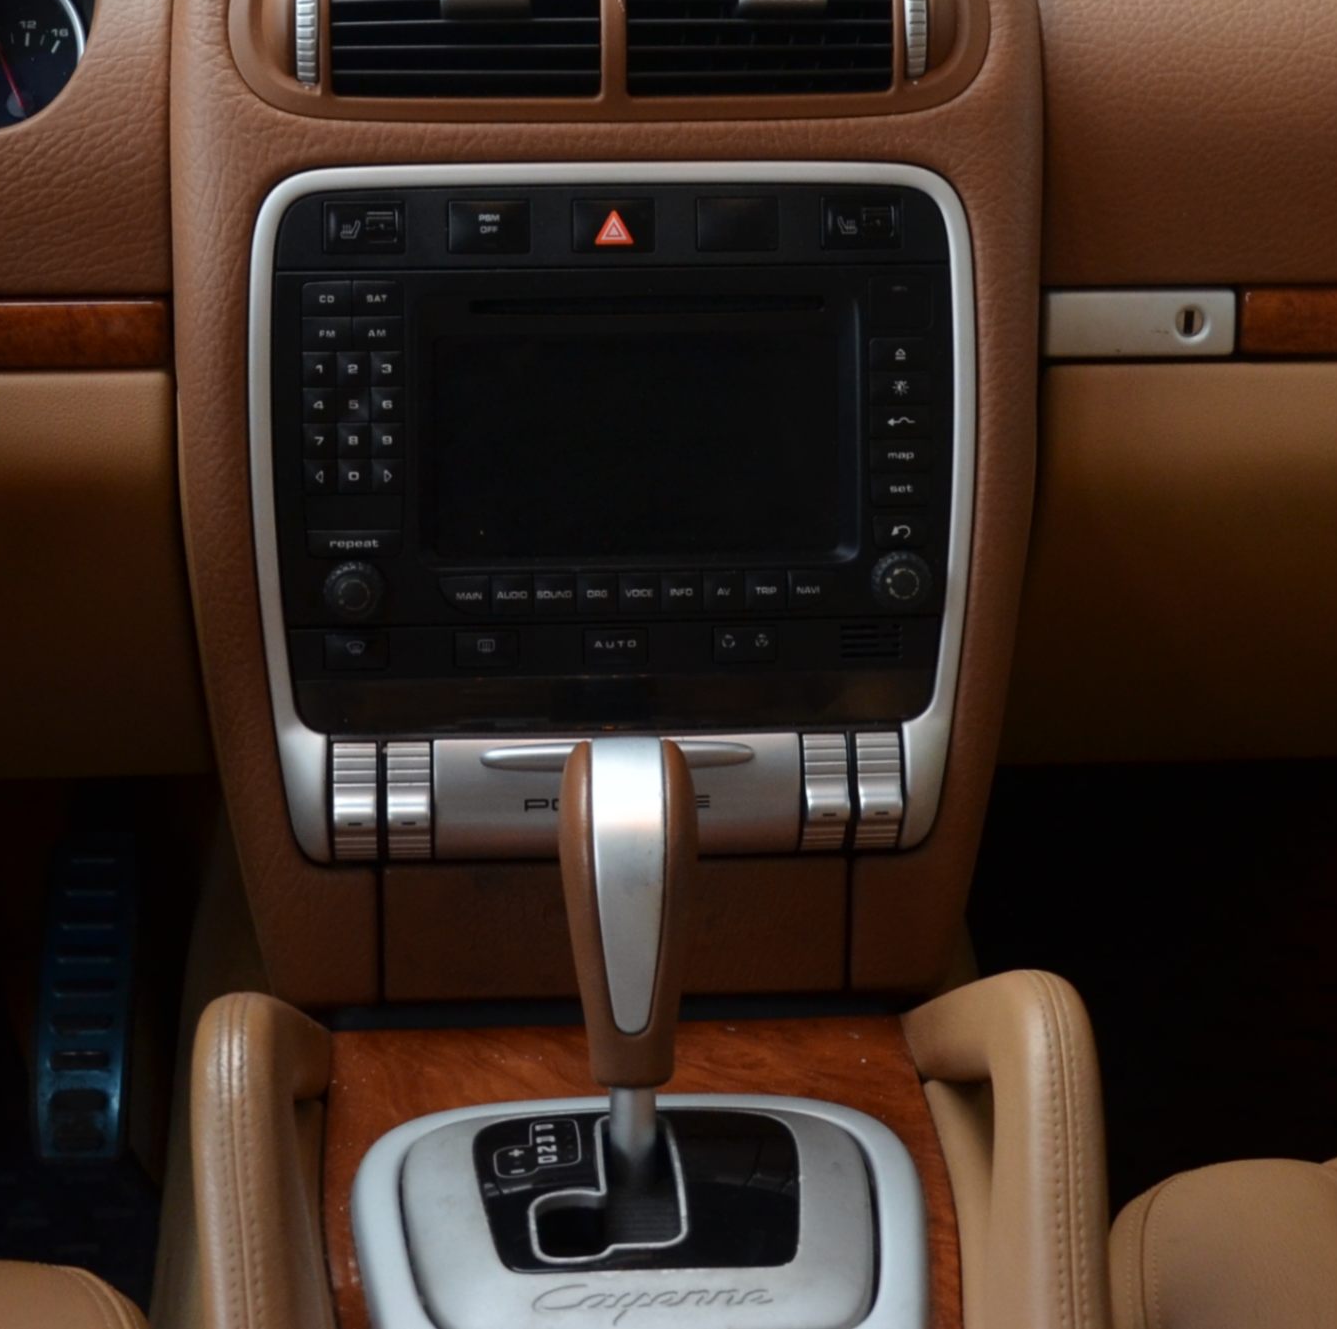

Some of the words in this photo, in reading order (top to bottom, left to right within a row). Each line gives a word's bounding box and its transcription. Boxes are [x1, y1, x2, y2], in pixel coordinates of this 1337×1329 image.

[19, 20, 37, 29] 12
[50, 28, 69, 37] 16
[479, 225, 500, 234] OFF
[318, 294, 335, 303] CD
[365, 294, 388, 303] SAT
[318, 329, 336, 338] FM
[367, 329, 387, 338] AM
[313, 363, 324, 374] 1
[347, 363, 359, 374] 2
[381, 363, 393, 374] 3
[313, 399, 324, 410] 4
[347, 399, 359, 410] 5
[381, 399, 393, 410] 6
[313, 435, 324, 446] 7
[347, 435, 359, 446] 8
[381, 435, 393, 446] 9
[887, 450, 915, 462] map
[347, 470, 360, 482] 0
[889, 483, 913, 494] set
[329, 539, 380, 550] repeat
[496, 590, 529, 600] AUDIO
[536, 589, 573, 600] SOUND
[625, 588, 655, 598] VOICE
[669, 587, 694, 597] INFO
[716, 587, 732, 597] AV
[754, 586, 778, 596] TRIP
[795, 585, 821, 595] NAVI
[455, 591, 483, 601] MAIN
[593, 639, 638, 650] AUTO
[531, 1282, 775, 1326] Cayenne
